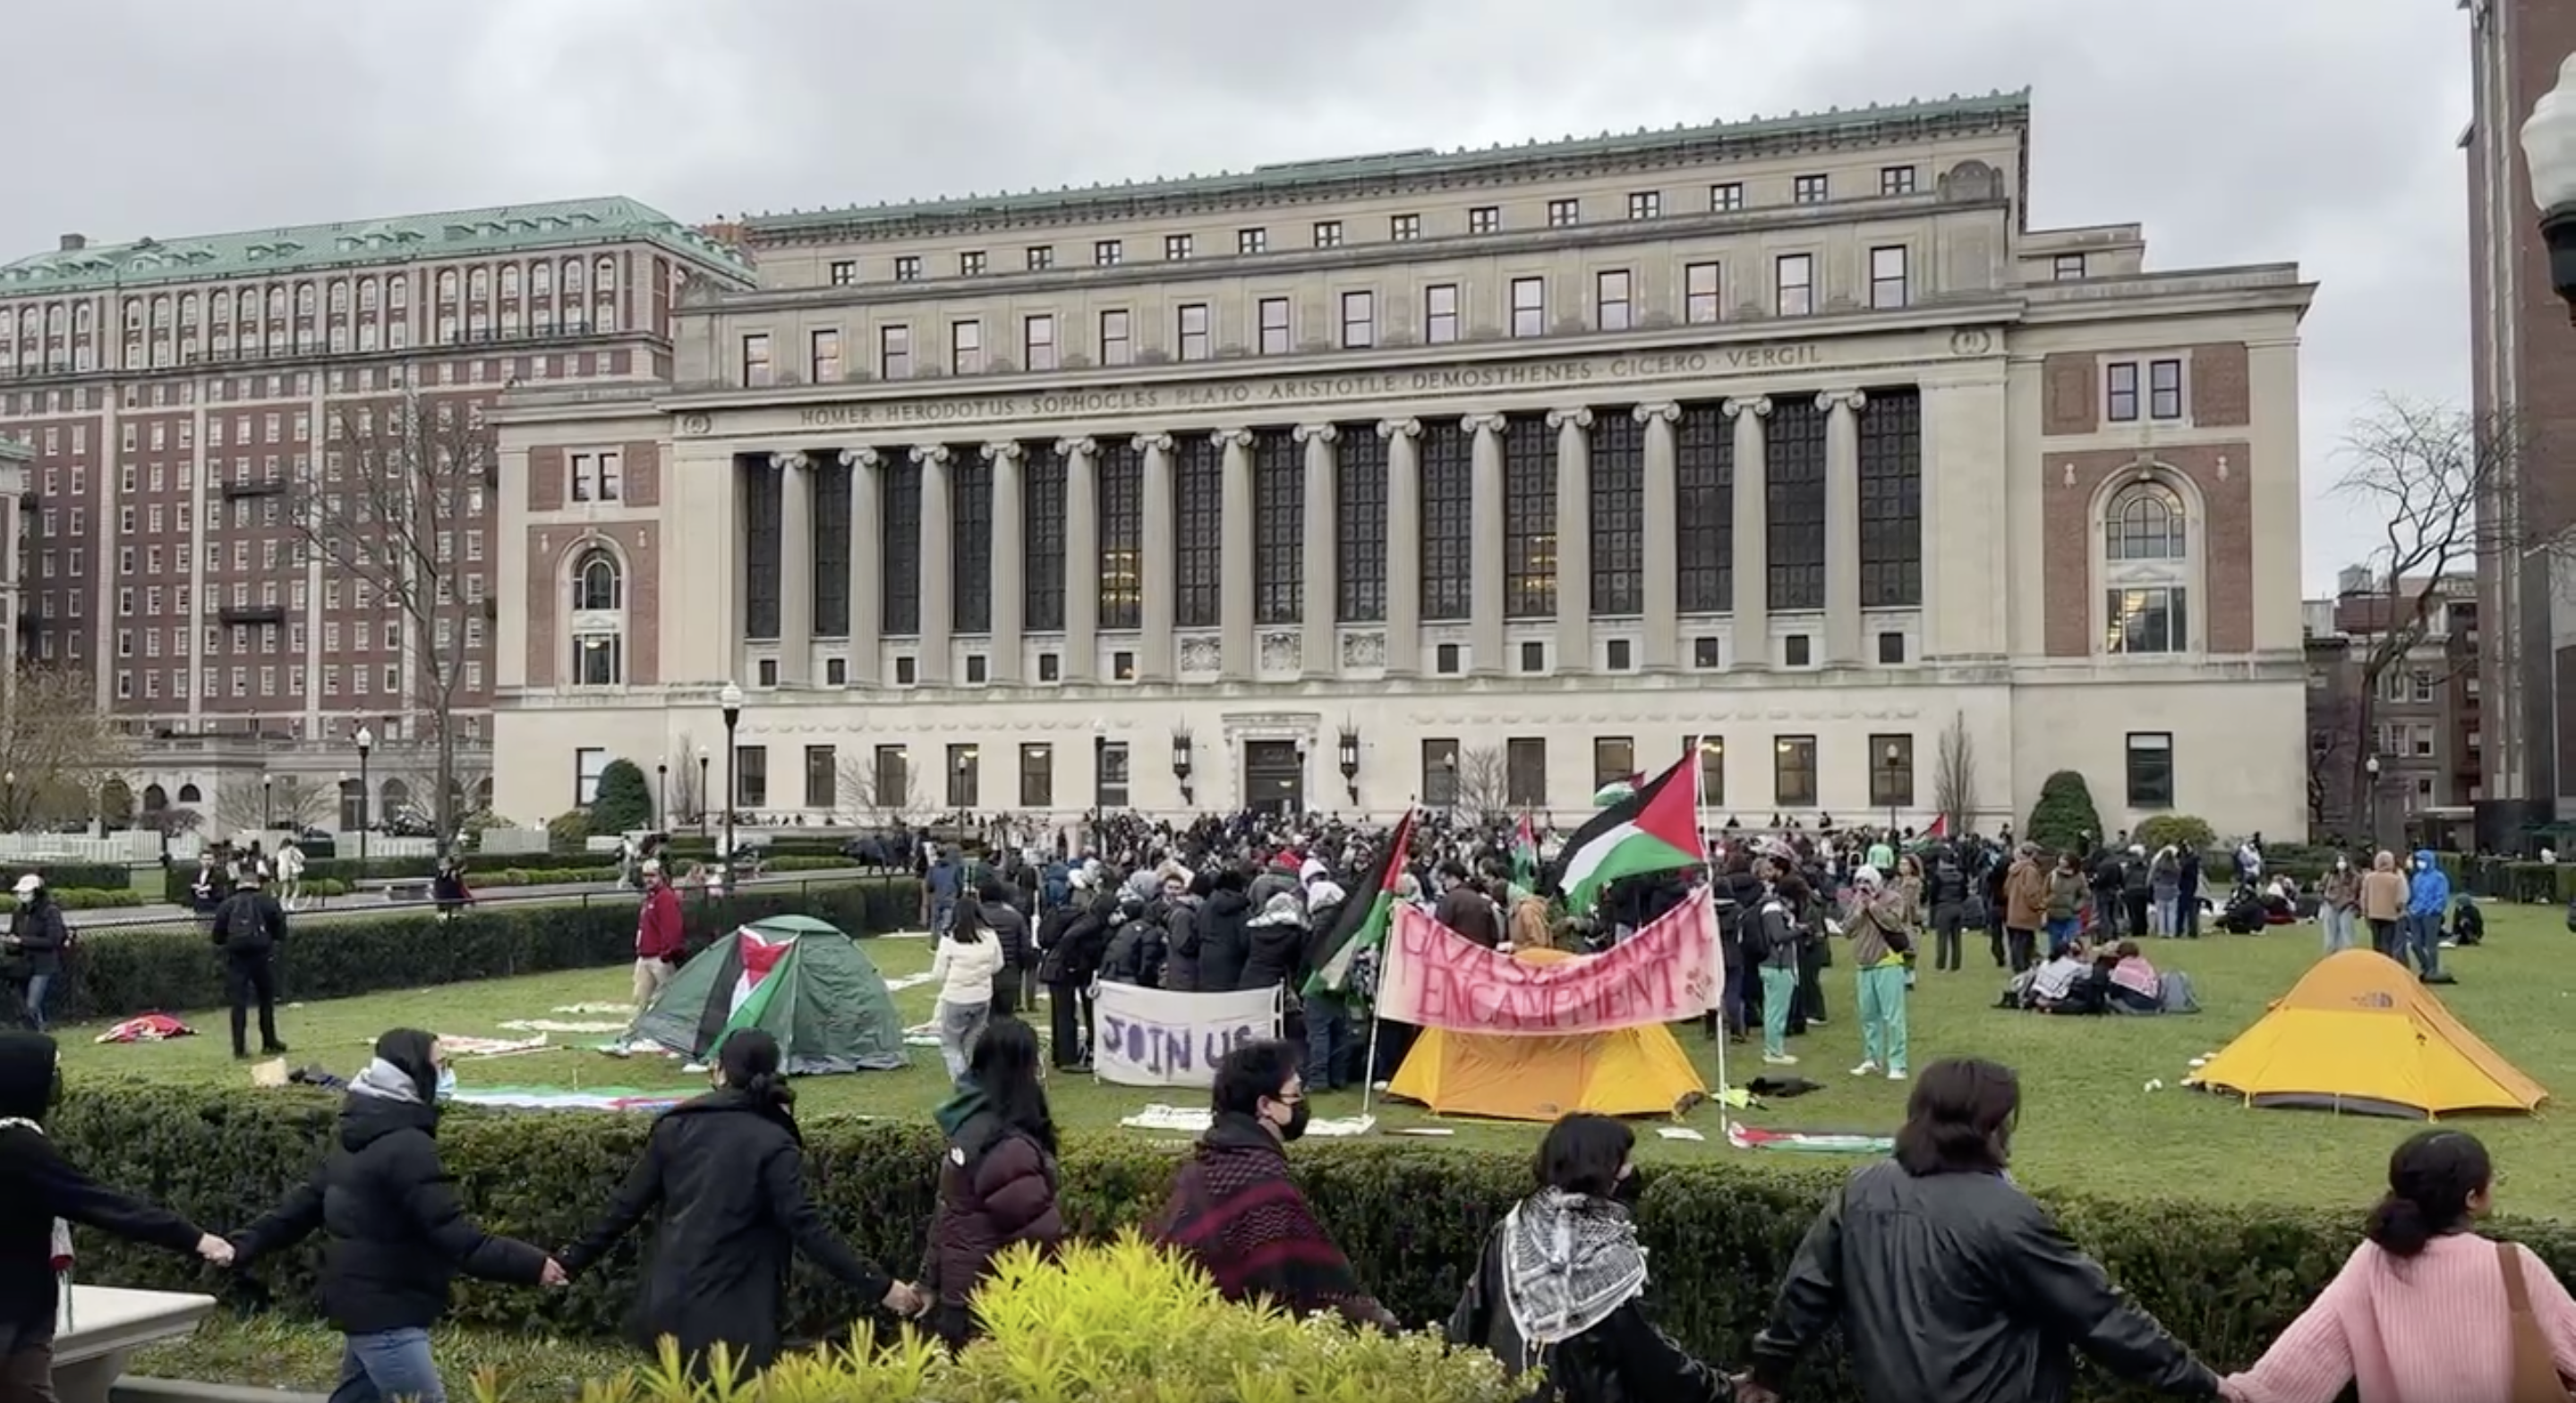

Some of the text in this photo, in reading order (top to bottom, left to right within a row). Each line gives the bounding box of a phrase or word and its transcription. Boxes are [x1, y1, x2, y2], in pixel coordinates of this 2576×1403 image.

[800, 344, 1822, 426] HOMER HERODOTUS SOPHOCLES PLATO ARISTOTLE DEMOSTHENES CICERO VERGIL
[1419, 957, 1677, 1027] ENCAMPMENT
[1103, 1015, 1191, 1079] JOIN
